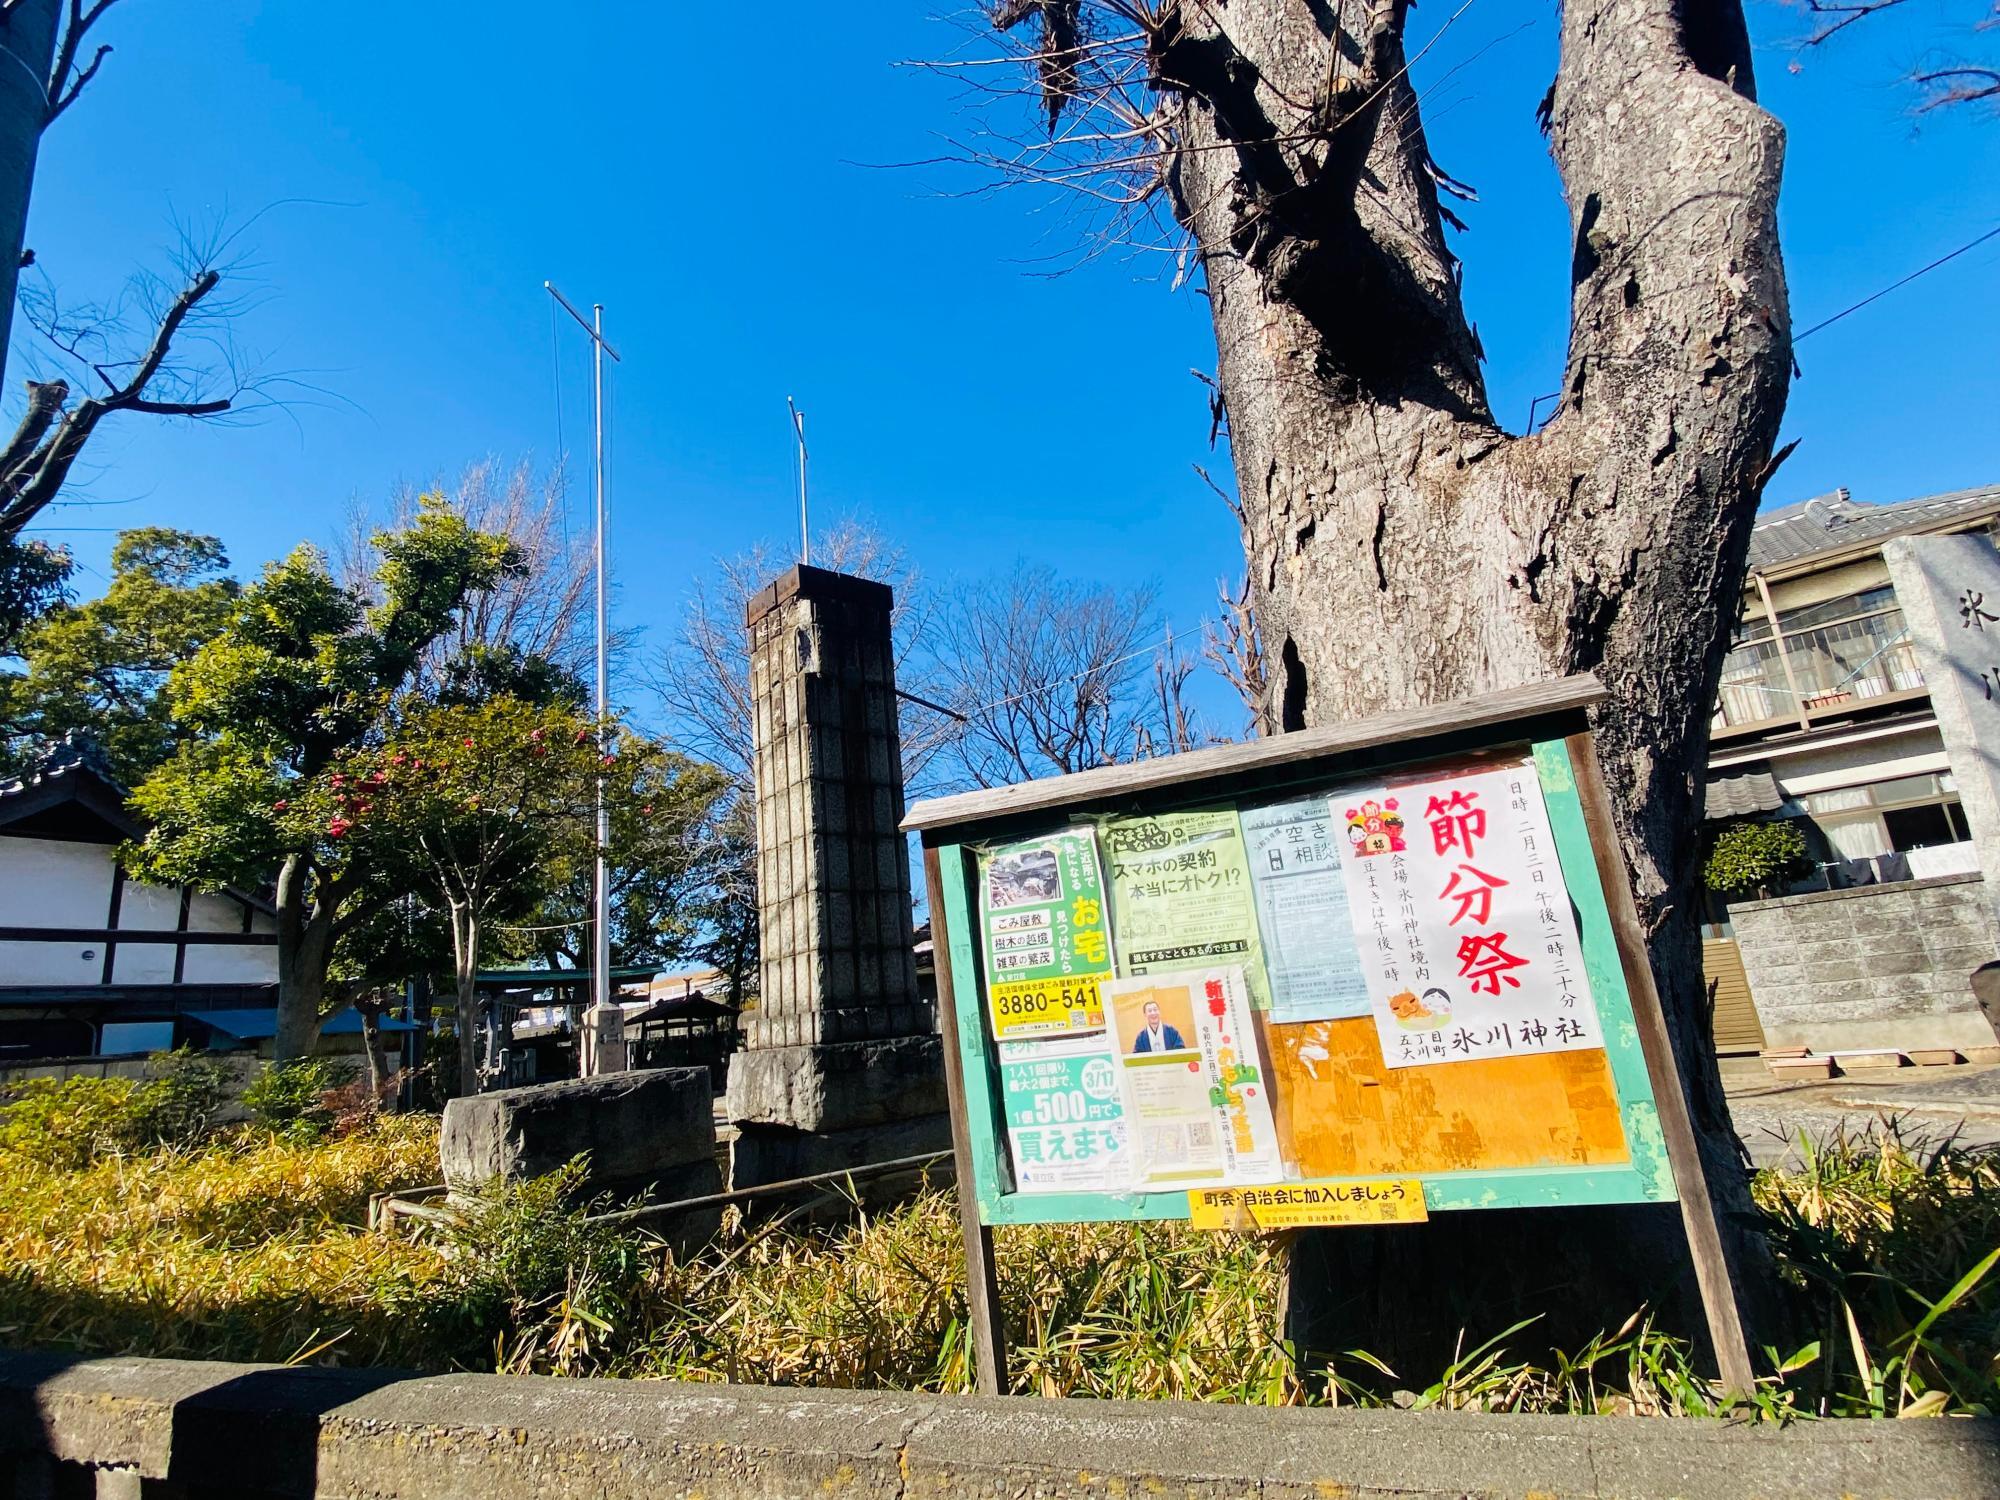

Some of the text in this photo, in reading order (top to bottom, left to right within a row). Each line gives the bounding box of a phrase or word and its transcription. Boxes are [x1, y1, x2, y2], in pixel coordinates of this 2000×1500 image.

[1113, 848, 1217, 880] スマホの契約
[1295, 842, 1340, 866] 相談
[1423, 790, 1531, 997] 節分祭
[1511, 781, 1577, 1008] 日時 二月三日 午後二時三十分
[998, 914, 1042, 930] ごみ屋敷
[1072, 895, 1106, 963] お宅
[1362, 860, 1400, 982] 豆まきは午後三時
[1391, 854, 1430, 981] 会場 氷川神社境内
[995, 932, 1049, 950] 樹木の越境
[1056, 910, 1072, 973] 見つけたら
[996, 951, 1051, 969] 雑草の繁茂
[1399, 1030, 1442, 1046] 五丁目
[1402, 1043, 1447, 1060] 大川町
[1452, 1017, 1587, 1053] 氷川神社
